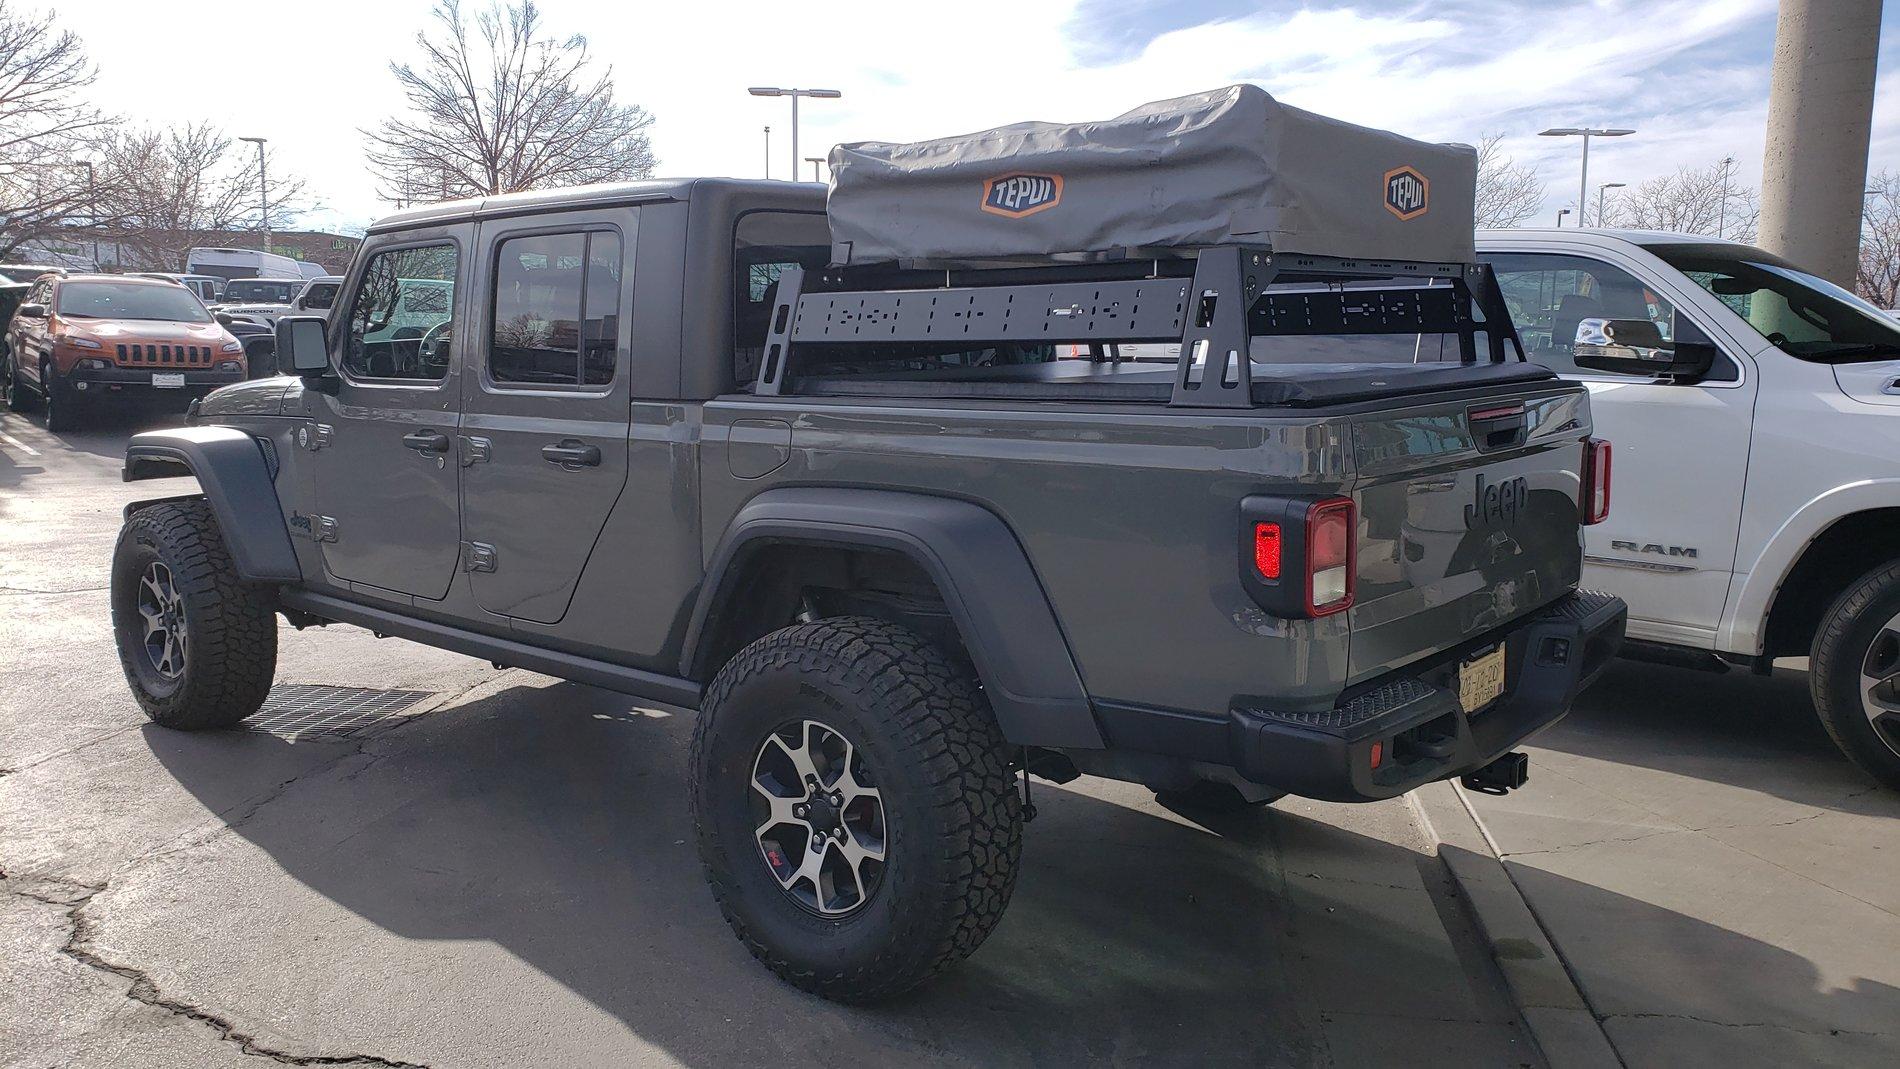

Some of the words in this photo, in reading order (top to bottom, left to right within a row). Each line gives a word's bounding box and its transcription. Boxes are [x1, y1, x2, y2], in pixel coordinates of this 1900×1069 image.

[996, 177, 1051, 208] TEPUI
[1390, 175, 1422, 210] TEPUI
[1464, 473, 1528, 531] Jeep
[1611, 540, 1697, 557] RAM
